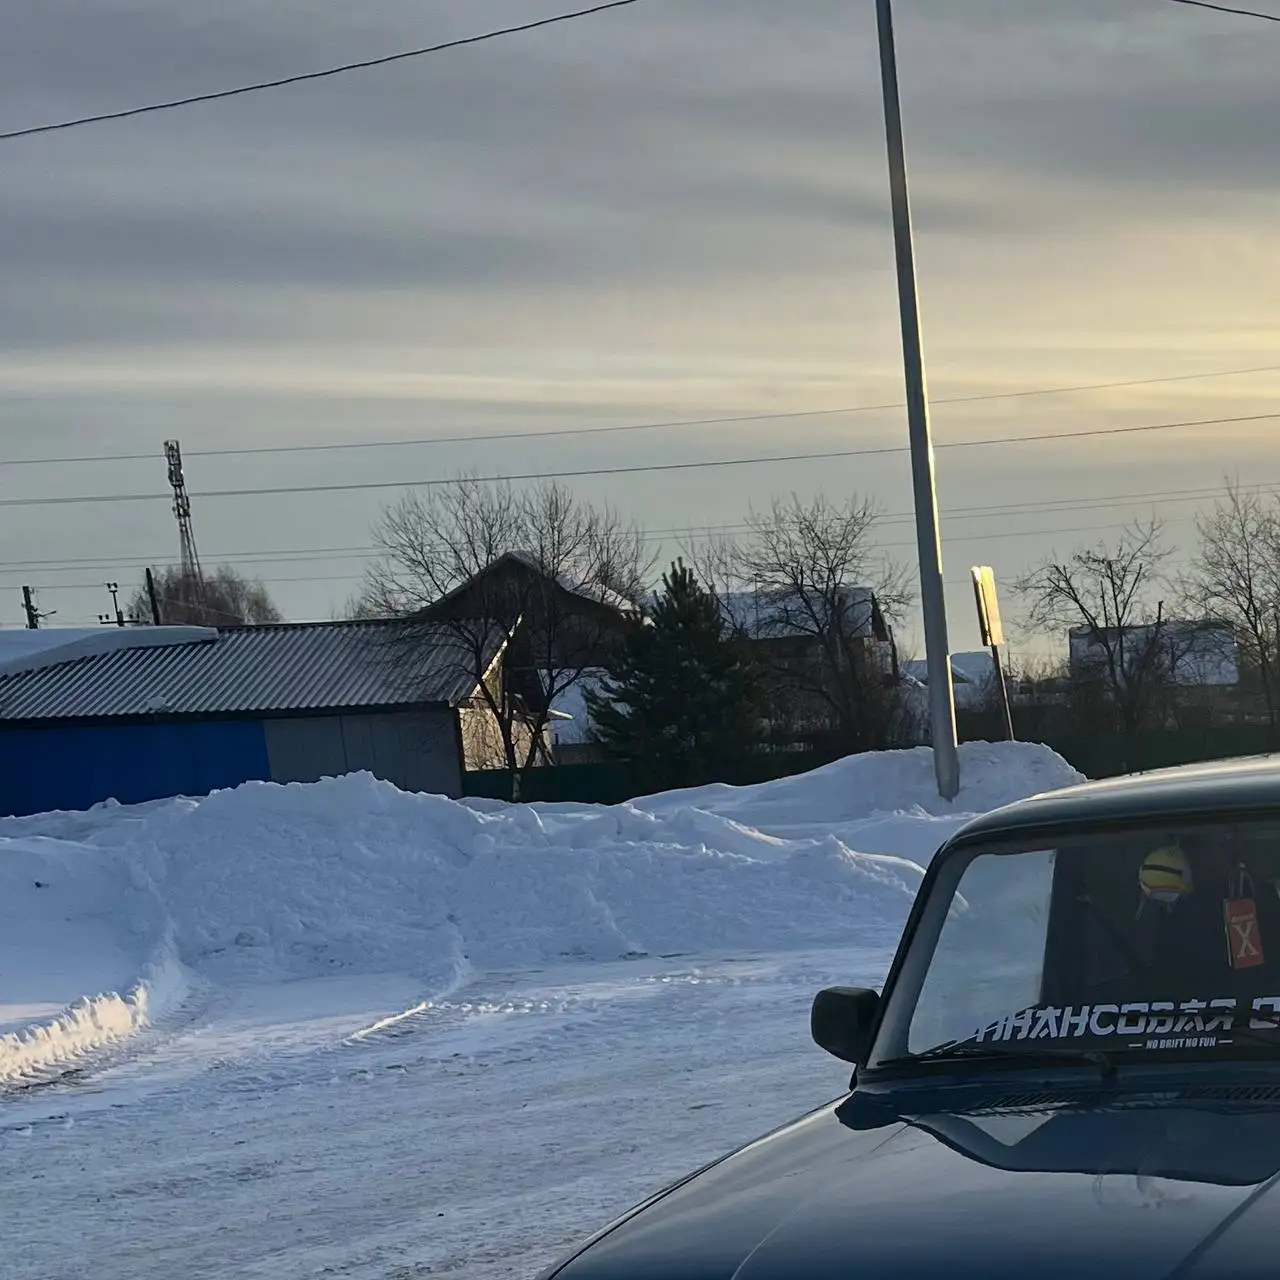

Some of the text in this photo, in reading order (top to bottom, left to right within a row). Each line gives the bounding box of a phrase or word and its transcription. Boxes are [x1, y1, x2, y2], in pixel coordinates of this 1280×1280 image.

[1146, 1037, 1217, 1049] NO DRIFT NO FUN
